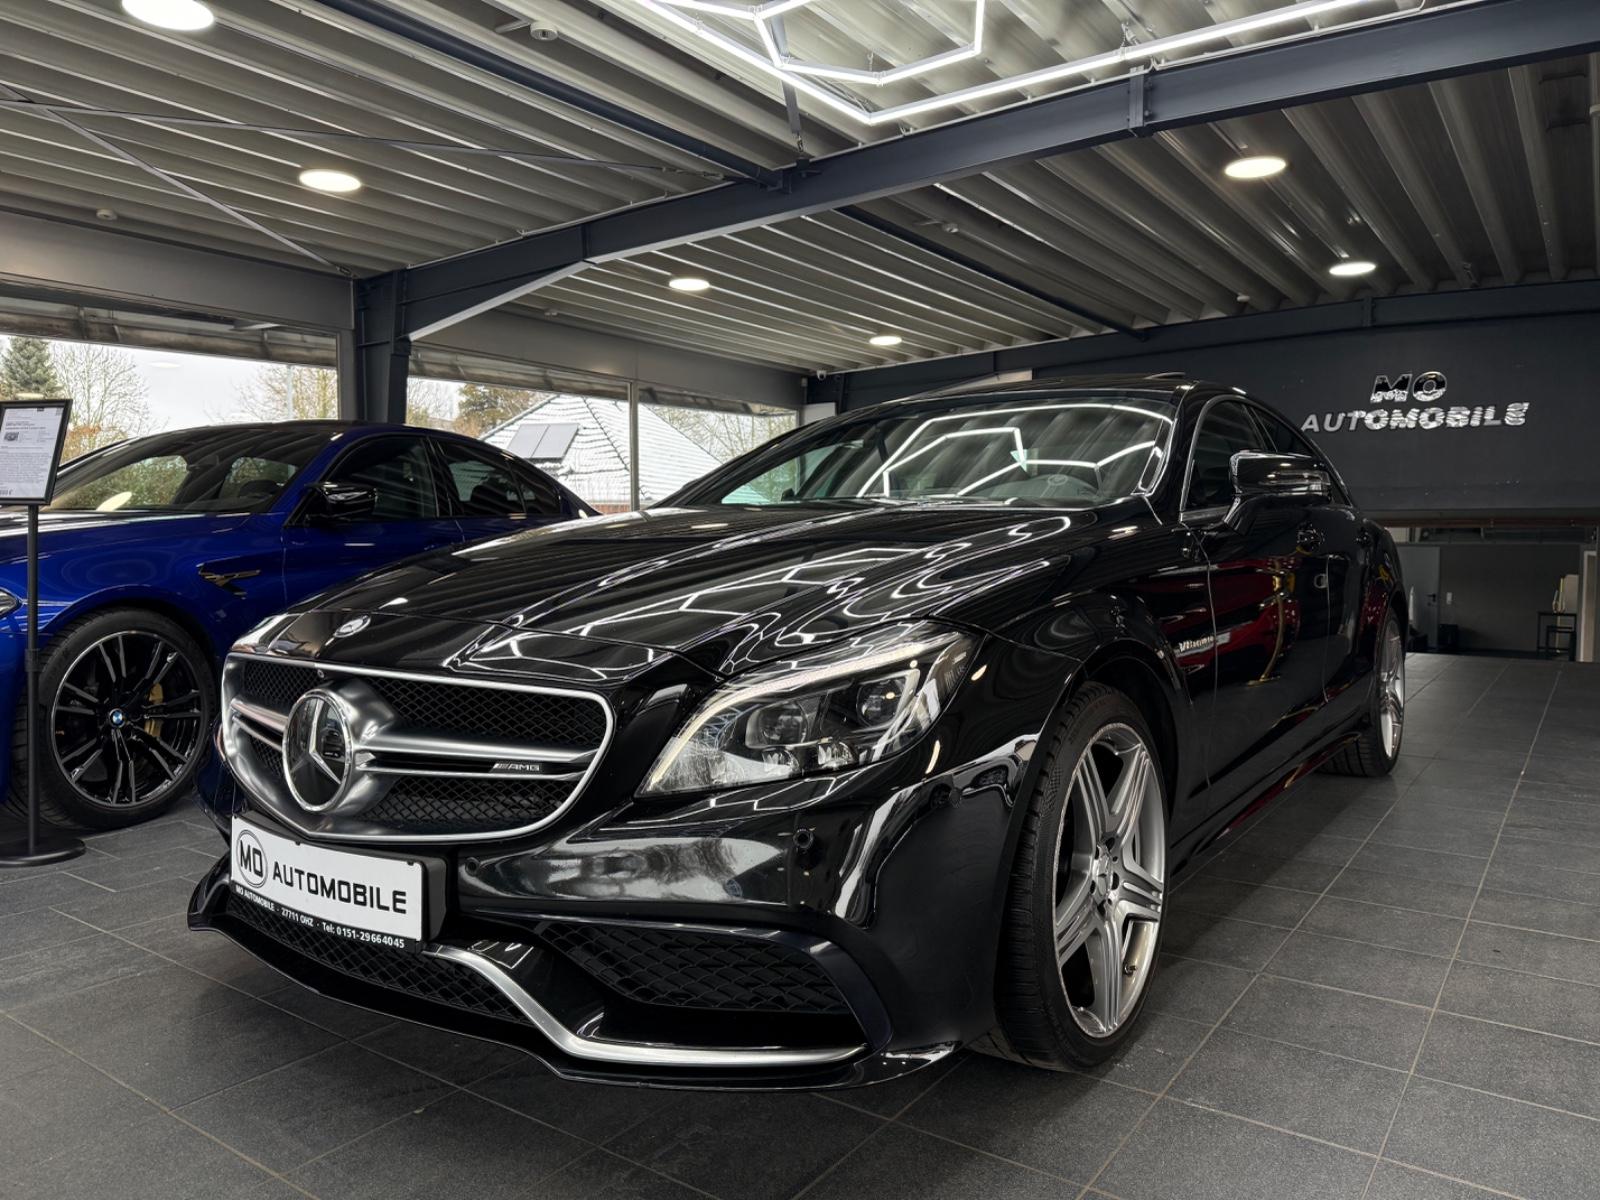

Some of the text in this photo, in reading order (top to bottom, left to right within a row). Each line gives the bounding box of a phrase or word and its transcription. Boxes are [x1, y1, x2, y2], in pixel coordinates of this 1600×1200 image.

[1370, 371, 1448, 403] MO
[1301, 402, 1530, 432] AUTOMOBILE
[239, 840, 407, 914] MO AUTOMOBILE
[235, 884, 244, 896] MO
[244, 889, 276, 912] AUTOMOBILE
[281, 907, 299, 922] 27711
[300, 914, 314, 927] OHZ
